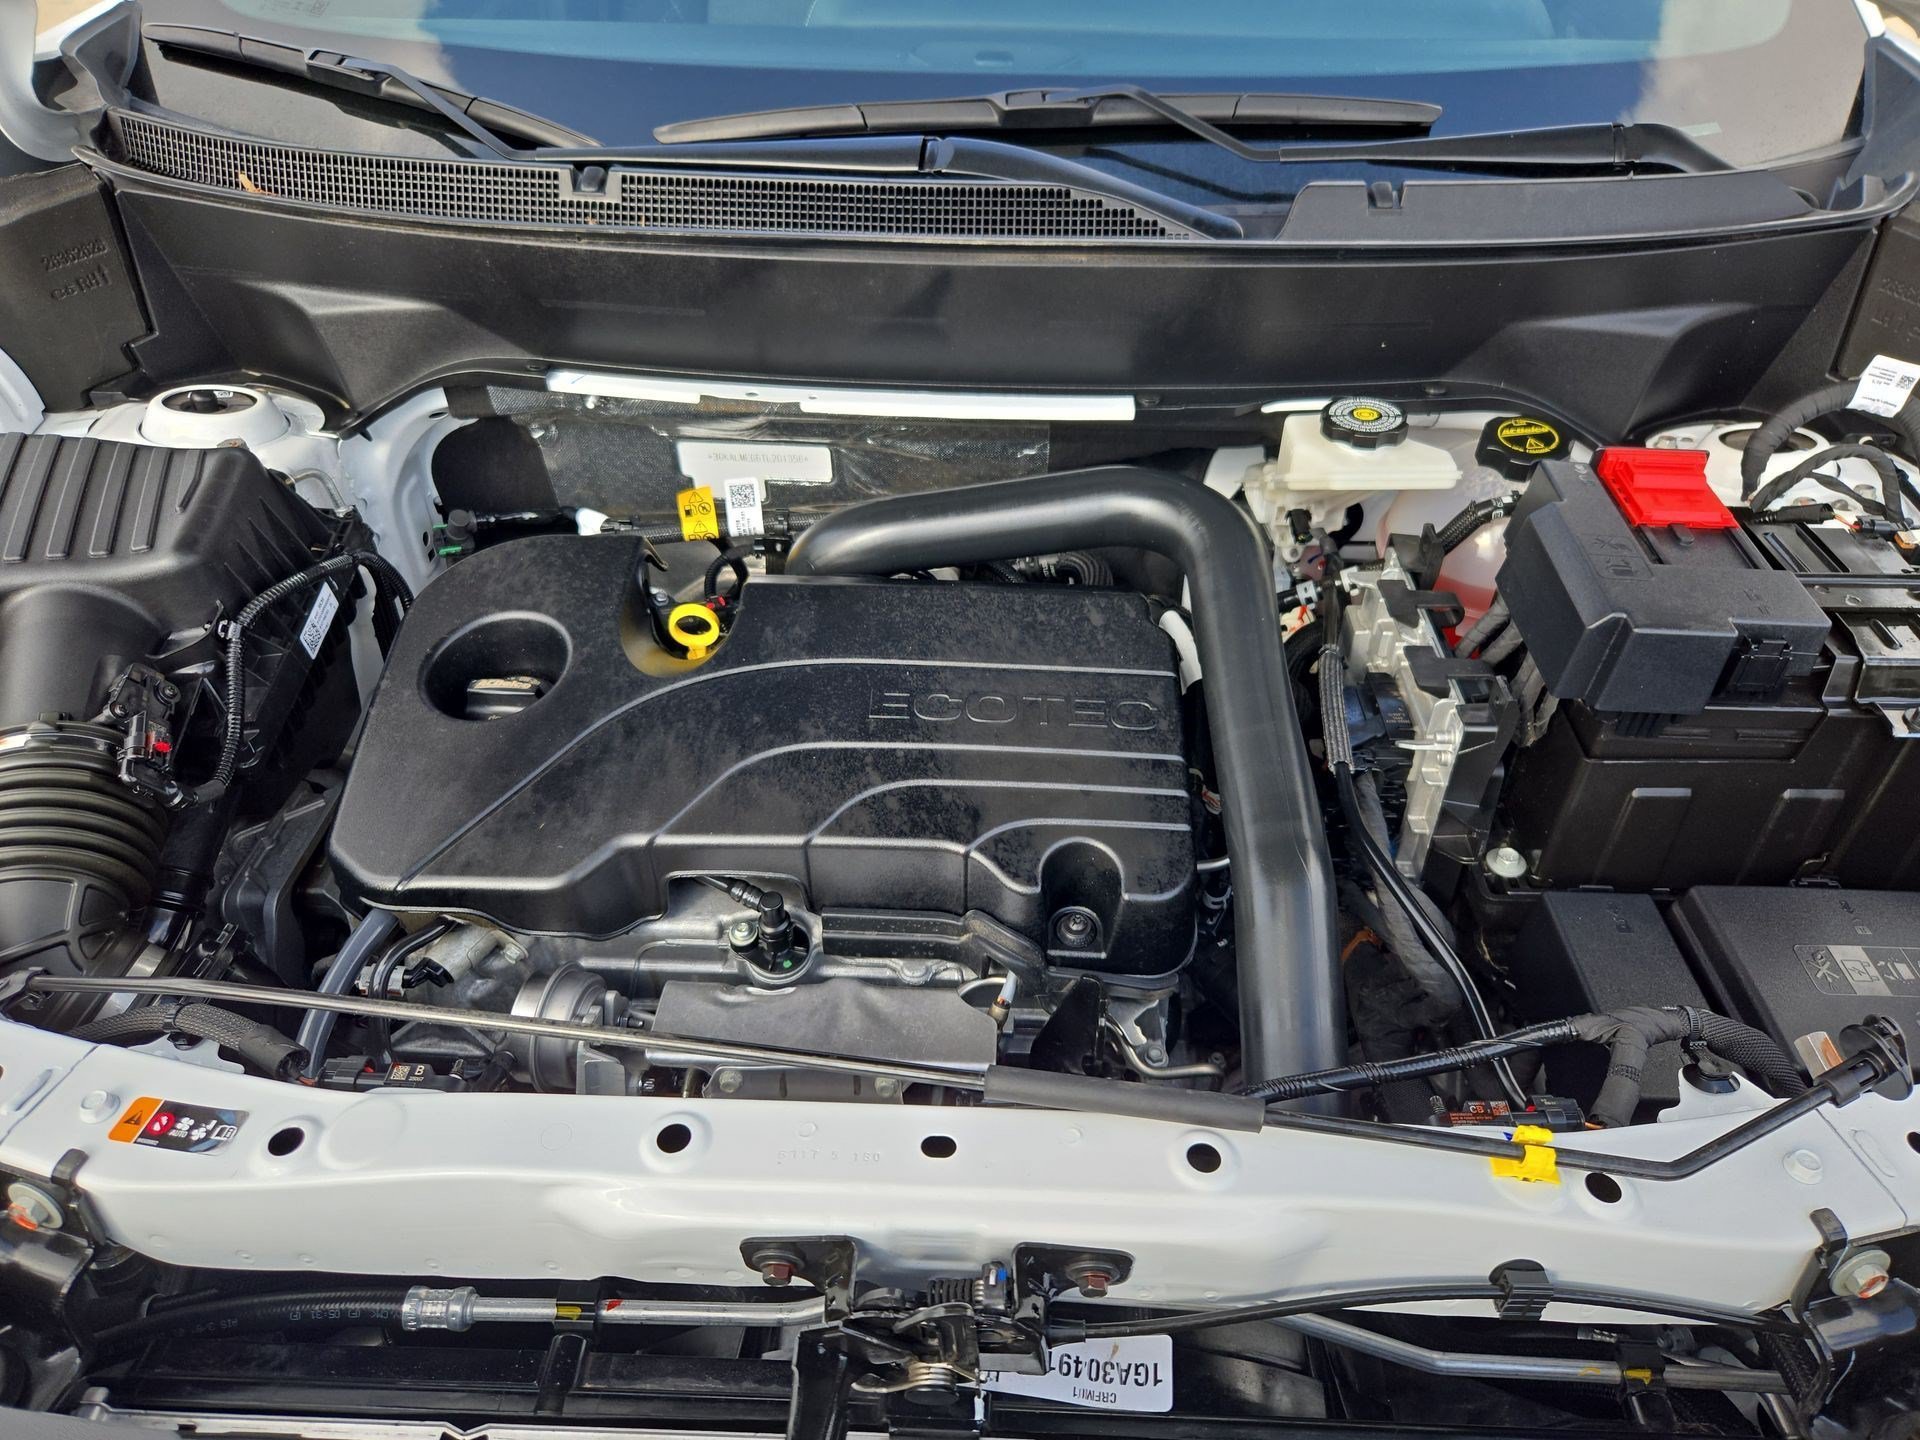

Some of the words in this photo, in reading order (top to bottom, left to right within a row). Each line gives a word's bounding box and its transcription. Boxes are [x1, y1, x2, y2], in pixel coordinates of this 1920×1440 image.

[868, 688, 1158, 730] ECOTEC
[414, 1065, 425, 1075] B
[1469, 1105, 1485, 1114] CB
[168, 1129, 189, 1138] AUTO
